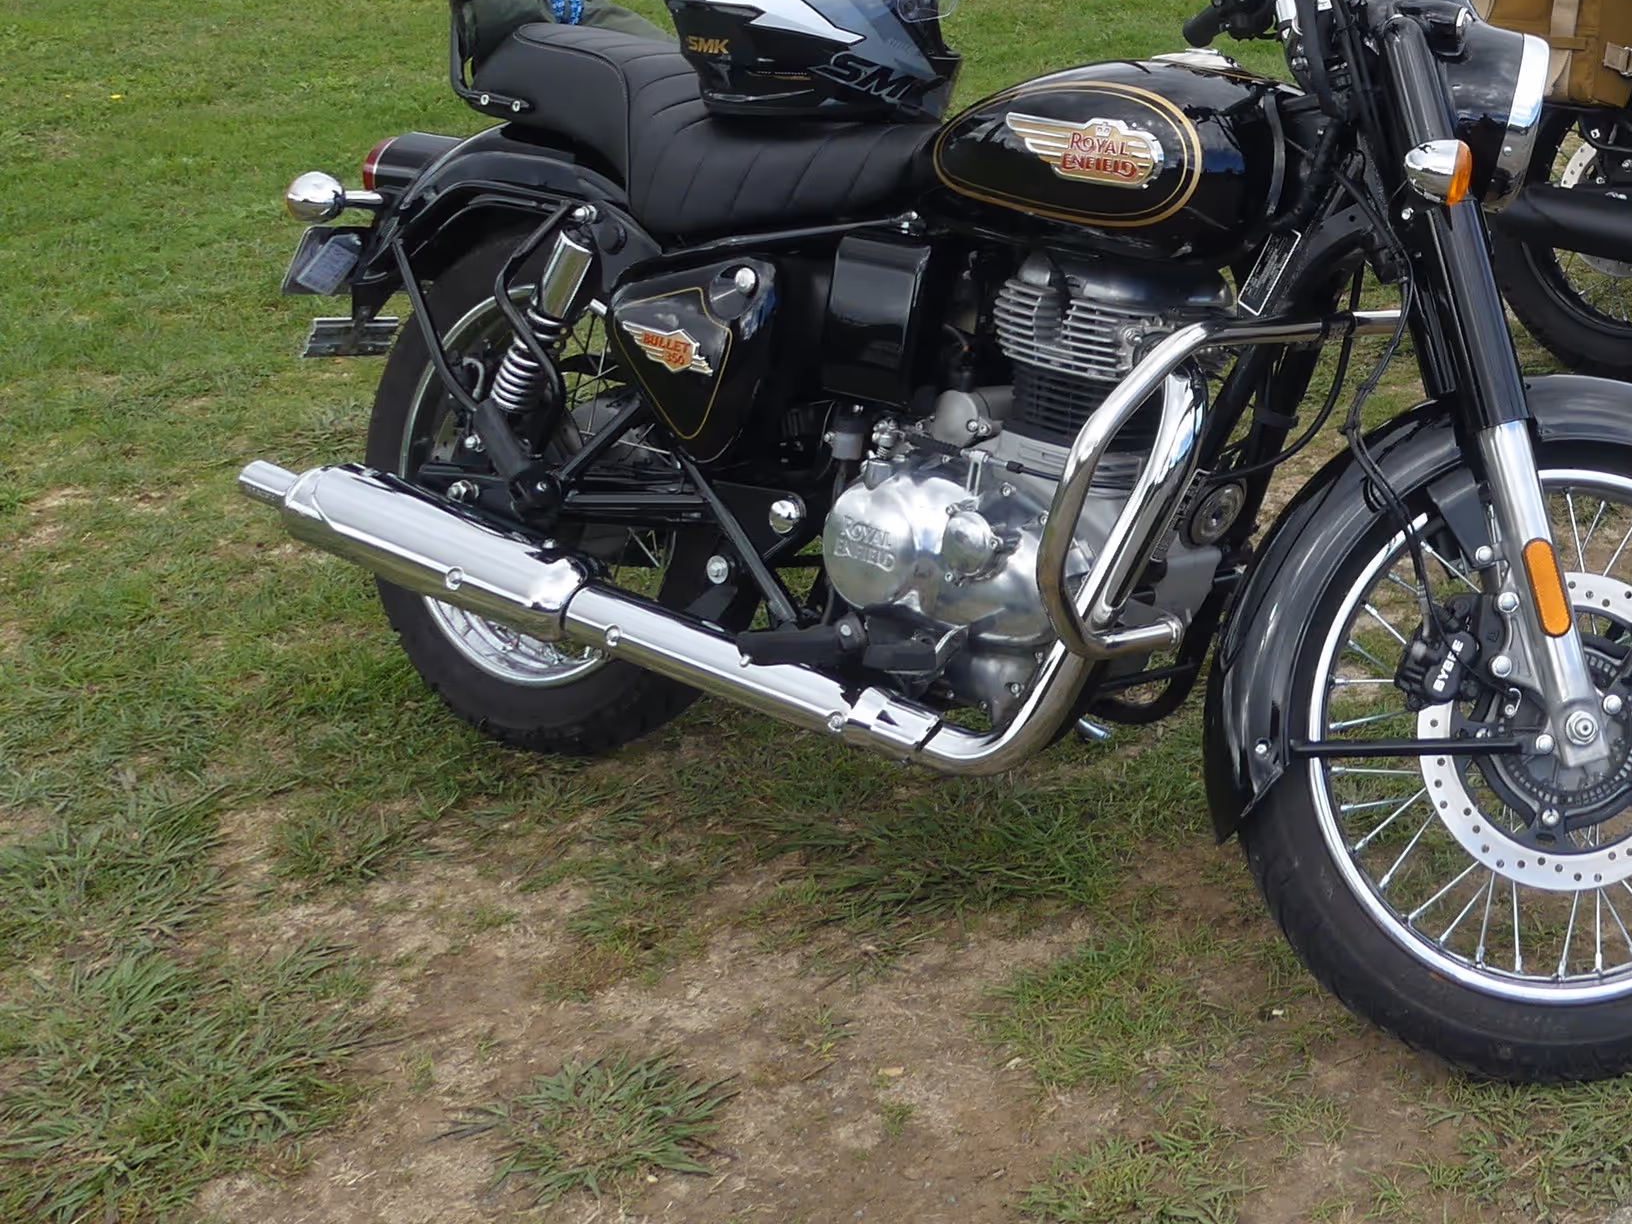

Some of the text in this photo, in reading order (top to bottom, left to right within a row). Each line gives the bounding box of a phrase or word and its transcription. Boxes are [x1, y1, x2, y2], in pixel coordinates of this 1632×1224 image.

[688, 35, 729, 54] SMK
[1070, 132, 1130, 157] ROYAL
[1061, 153, 1138, 178] ENFIELD
[643, 332, 691, 354] BULLET
